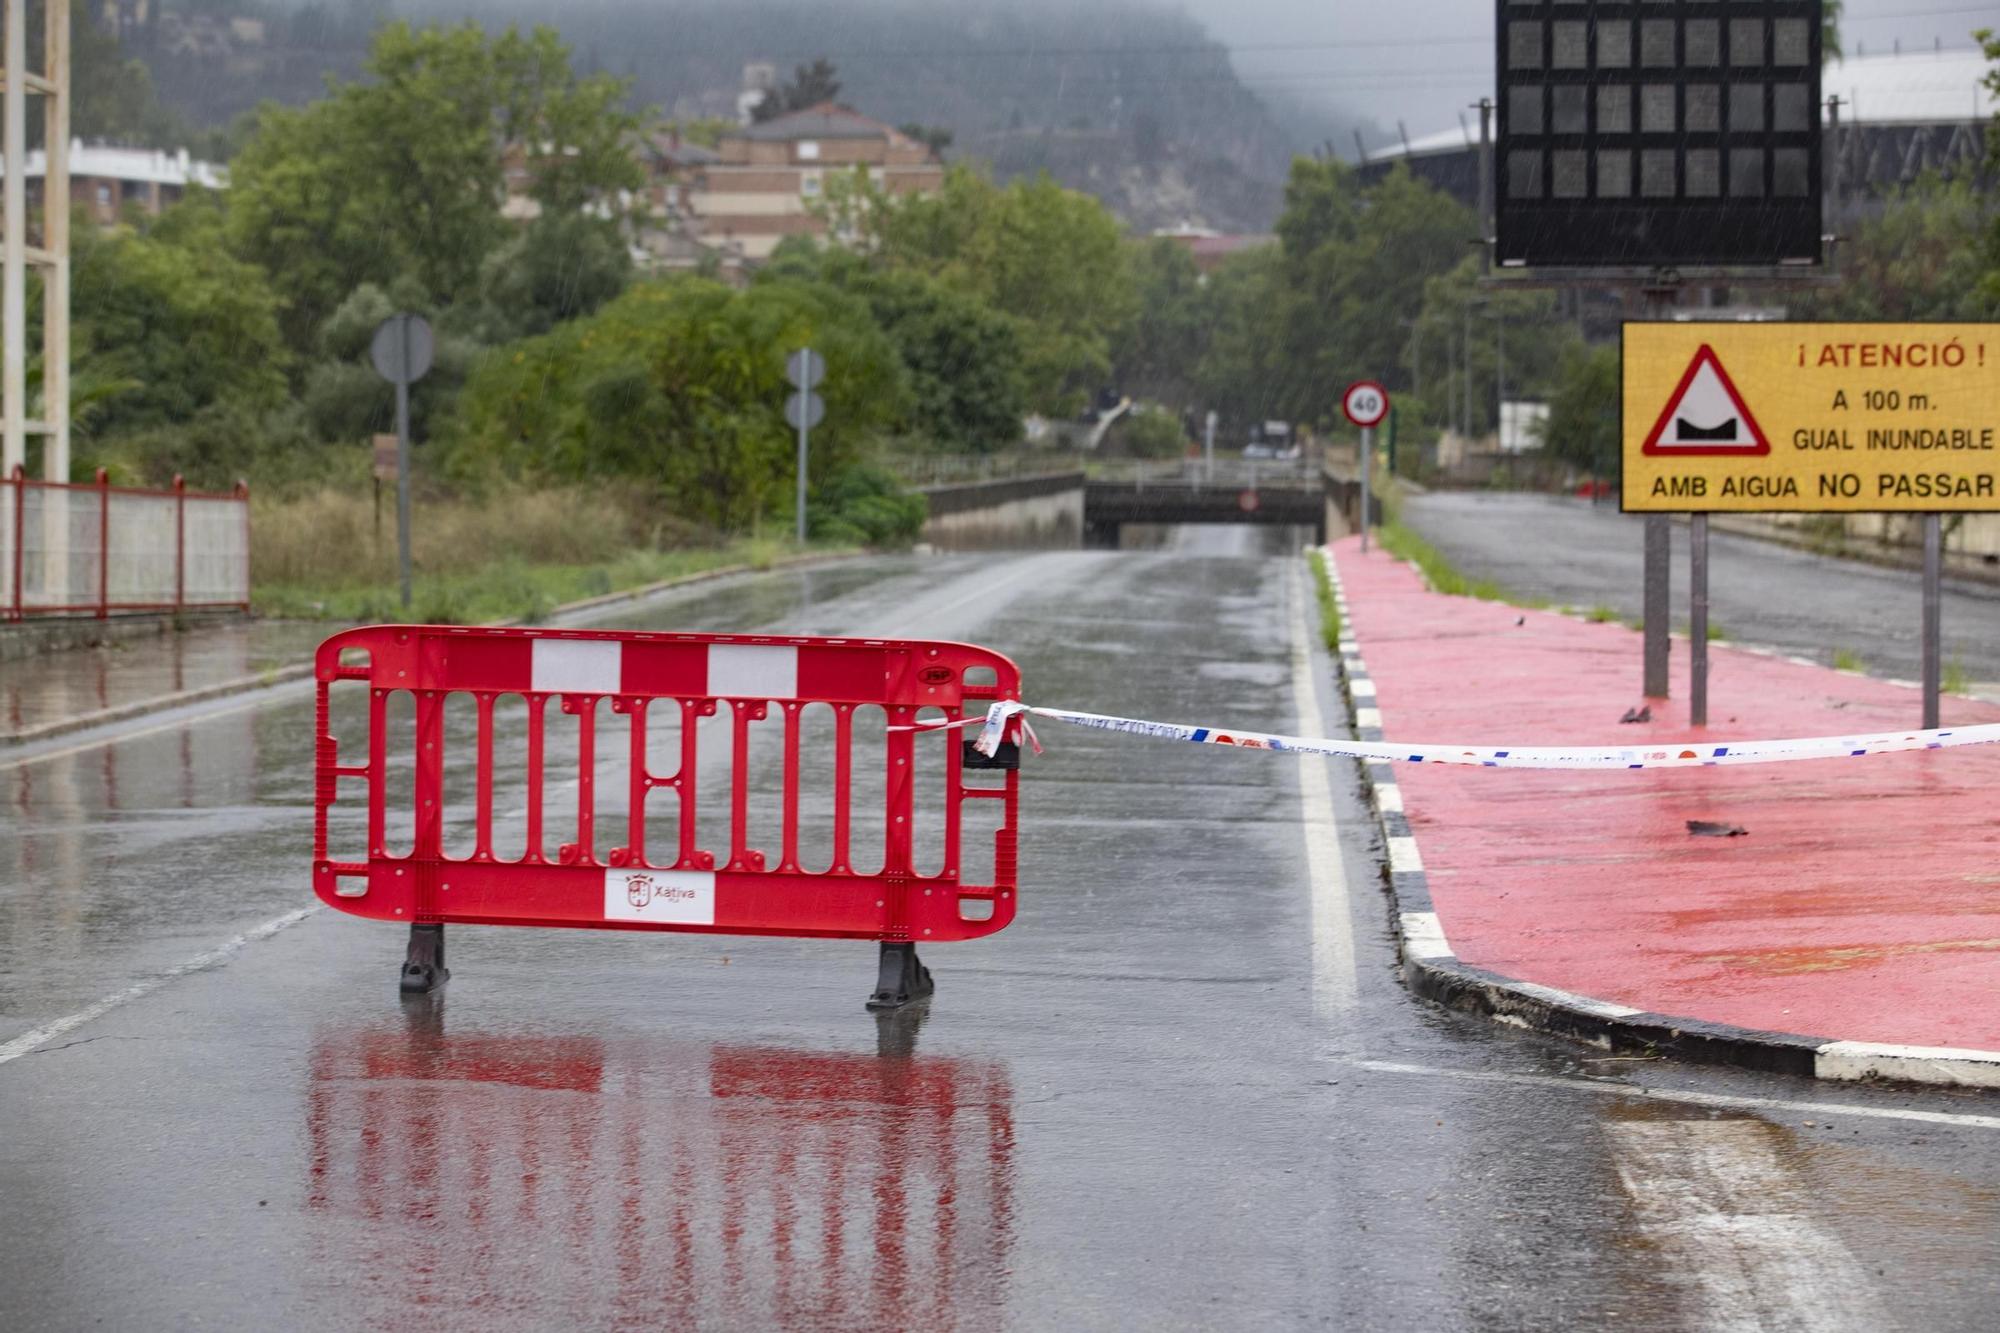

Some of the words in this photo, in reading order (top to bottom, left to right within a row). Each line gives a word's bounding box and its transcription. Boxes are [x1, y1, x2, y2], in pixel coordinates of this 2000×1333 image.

[1354, 395, 1378, 414] 40
[1832, 390, 1849, 411] A
[1863, 390, 1900, 411] 100
[1908, 395, 1938, 411] m.
[1792, 429, 1854, 450] GUAL
[1867, 429, 1994, 450] INUNDABLE
[1651, 476, 1708, 497] AMB
[1721, 476, 1799, 497] AIGUA
[1818, 474, 1861, 498] NO
[1878, 474, 1994, 498] PASSAR
